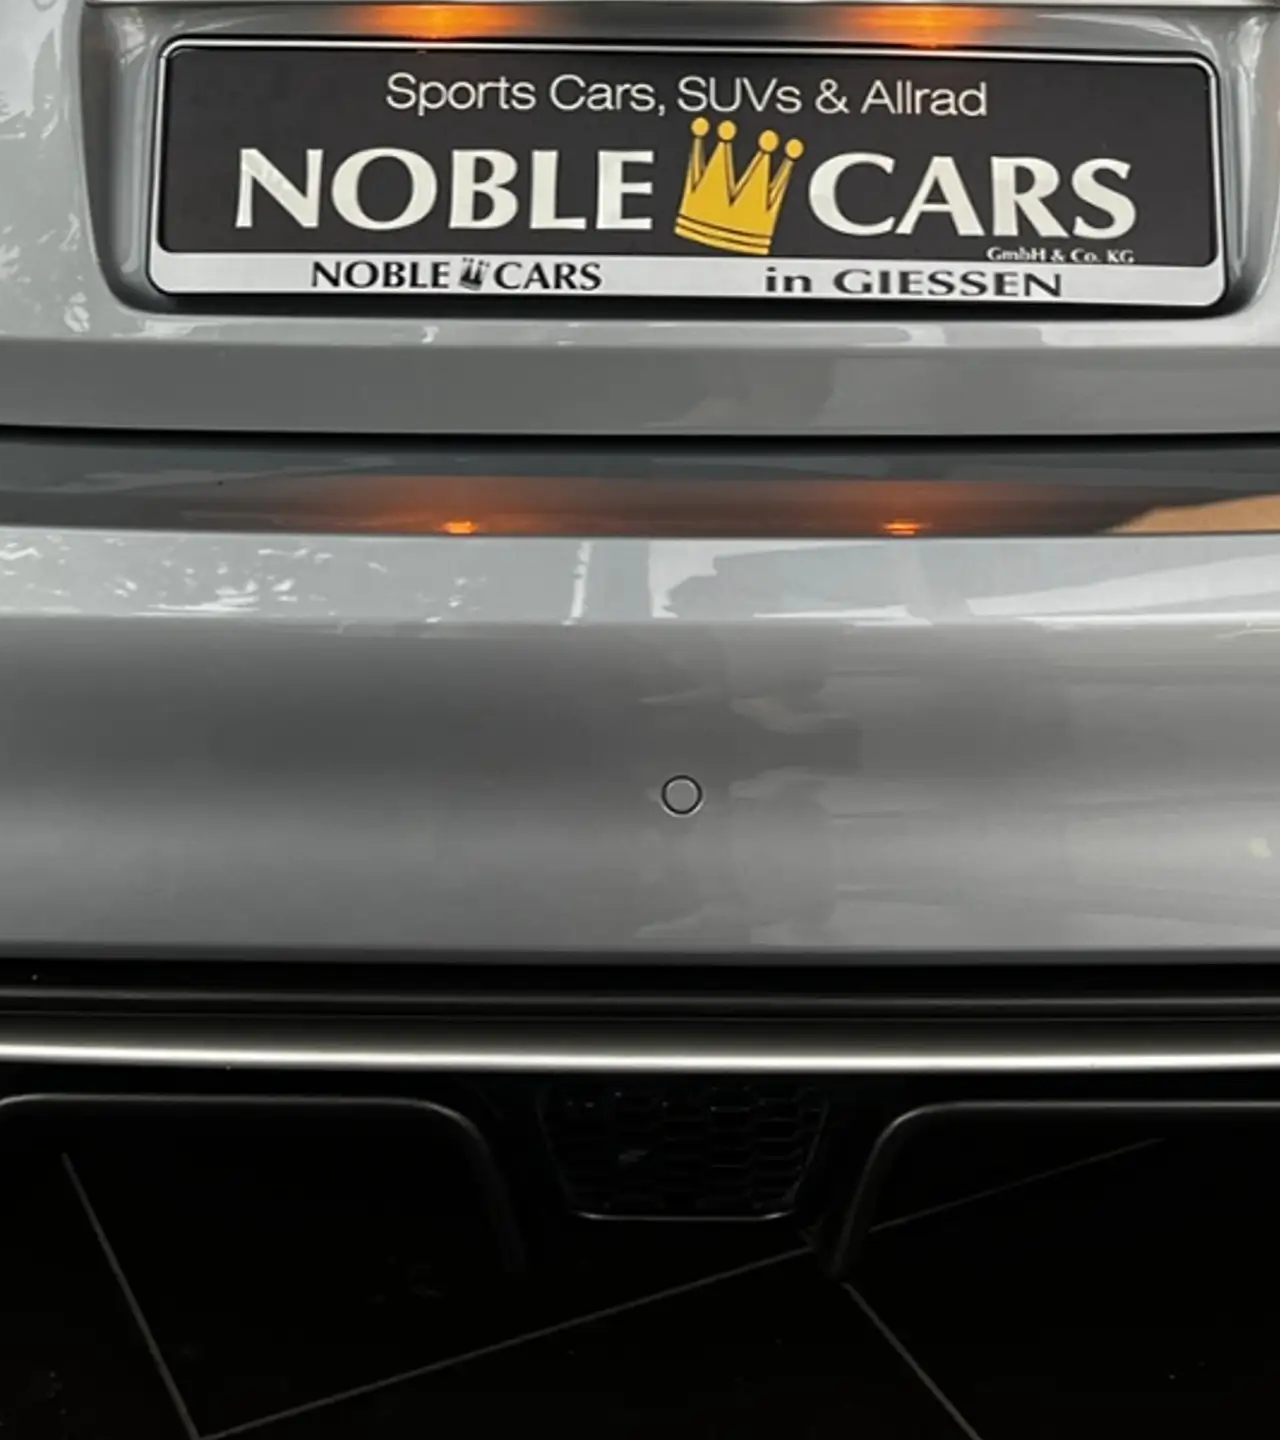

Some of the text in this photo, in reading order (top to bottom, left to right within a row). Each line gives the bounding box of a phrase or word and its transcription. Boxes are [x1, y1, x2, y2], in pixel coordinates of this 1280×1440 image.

[386, 72, 988, 117] Sports Cars, SUVs & Allrad
[235, 146, 1138, 240] NOBLE CARS
[986, 246, 1135, 264] GmbH & Co. KG
[311, 261, 602, 291] NOBLE CARS
[764, 267, 1062, 297] in GIESSEN
